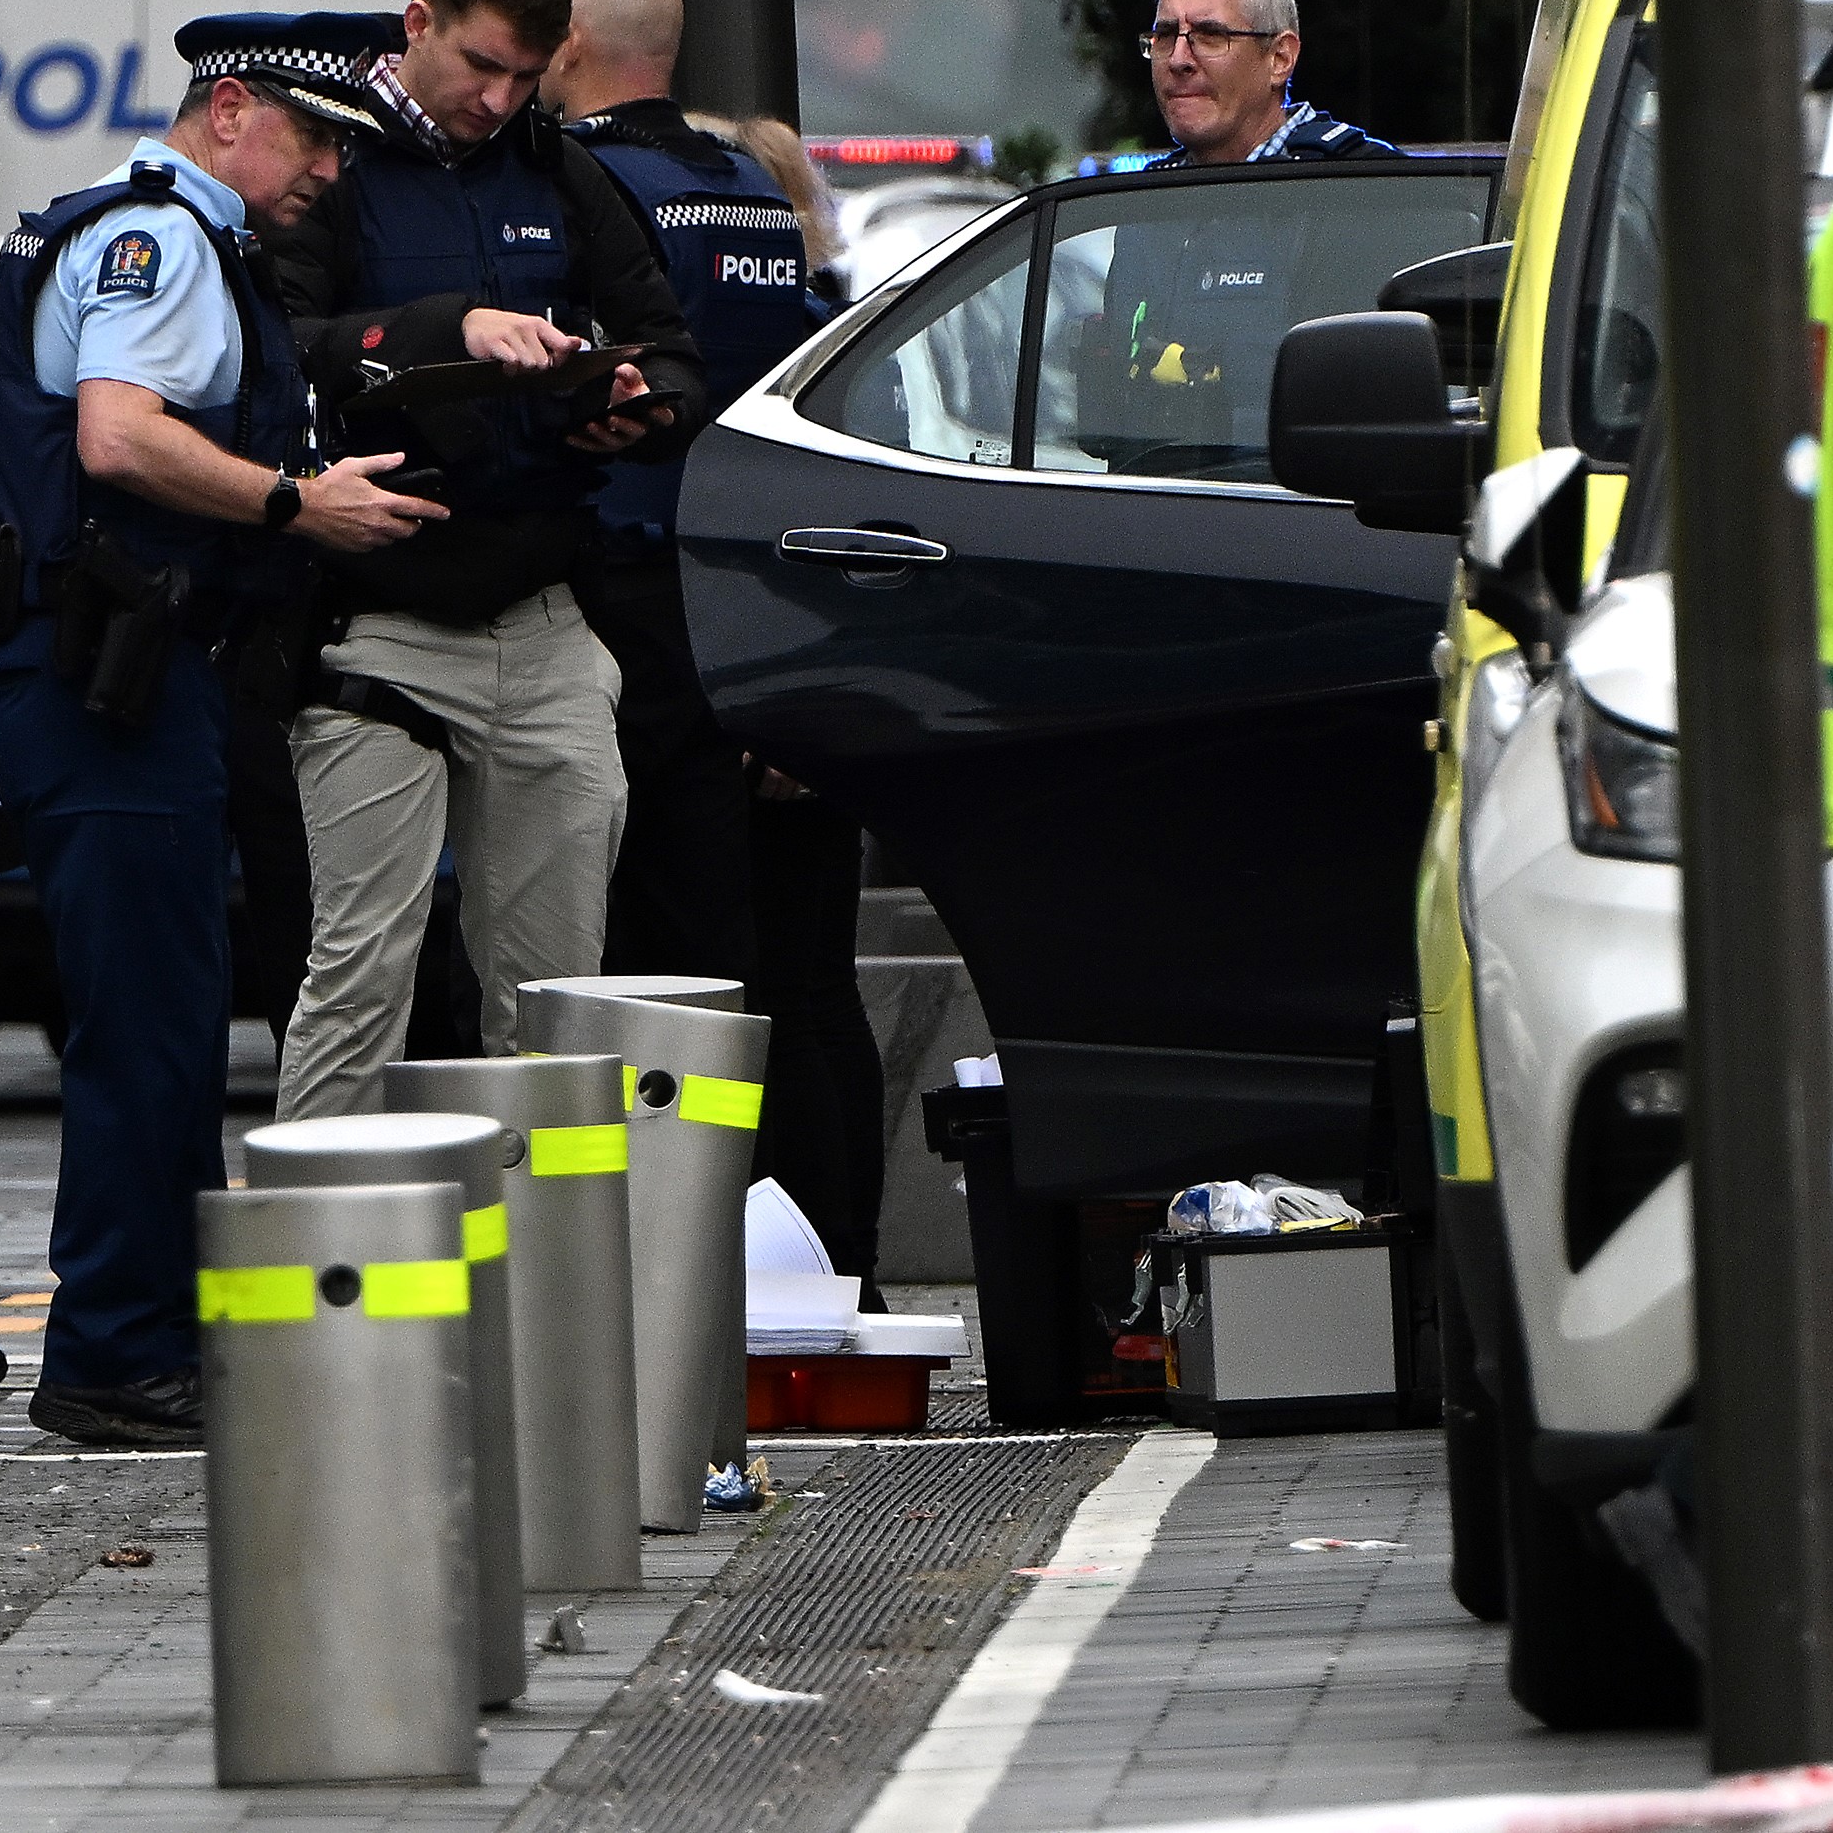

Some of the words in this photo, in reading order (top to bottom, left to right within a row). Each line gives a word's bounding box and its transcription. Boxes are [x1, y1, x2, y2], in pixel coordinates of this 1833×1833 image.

[722, 254, 797, 286] POLICE
[102, 277, 150, 289] POLICE
[1218, 272, 1265, 286] POLICE
